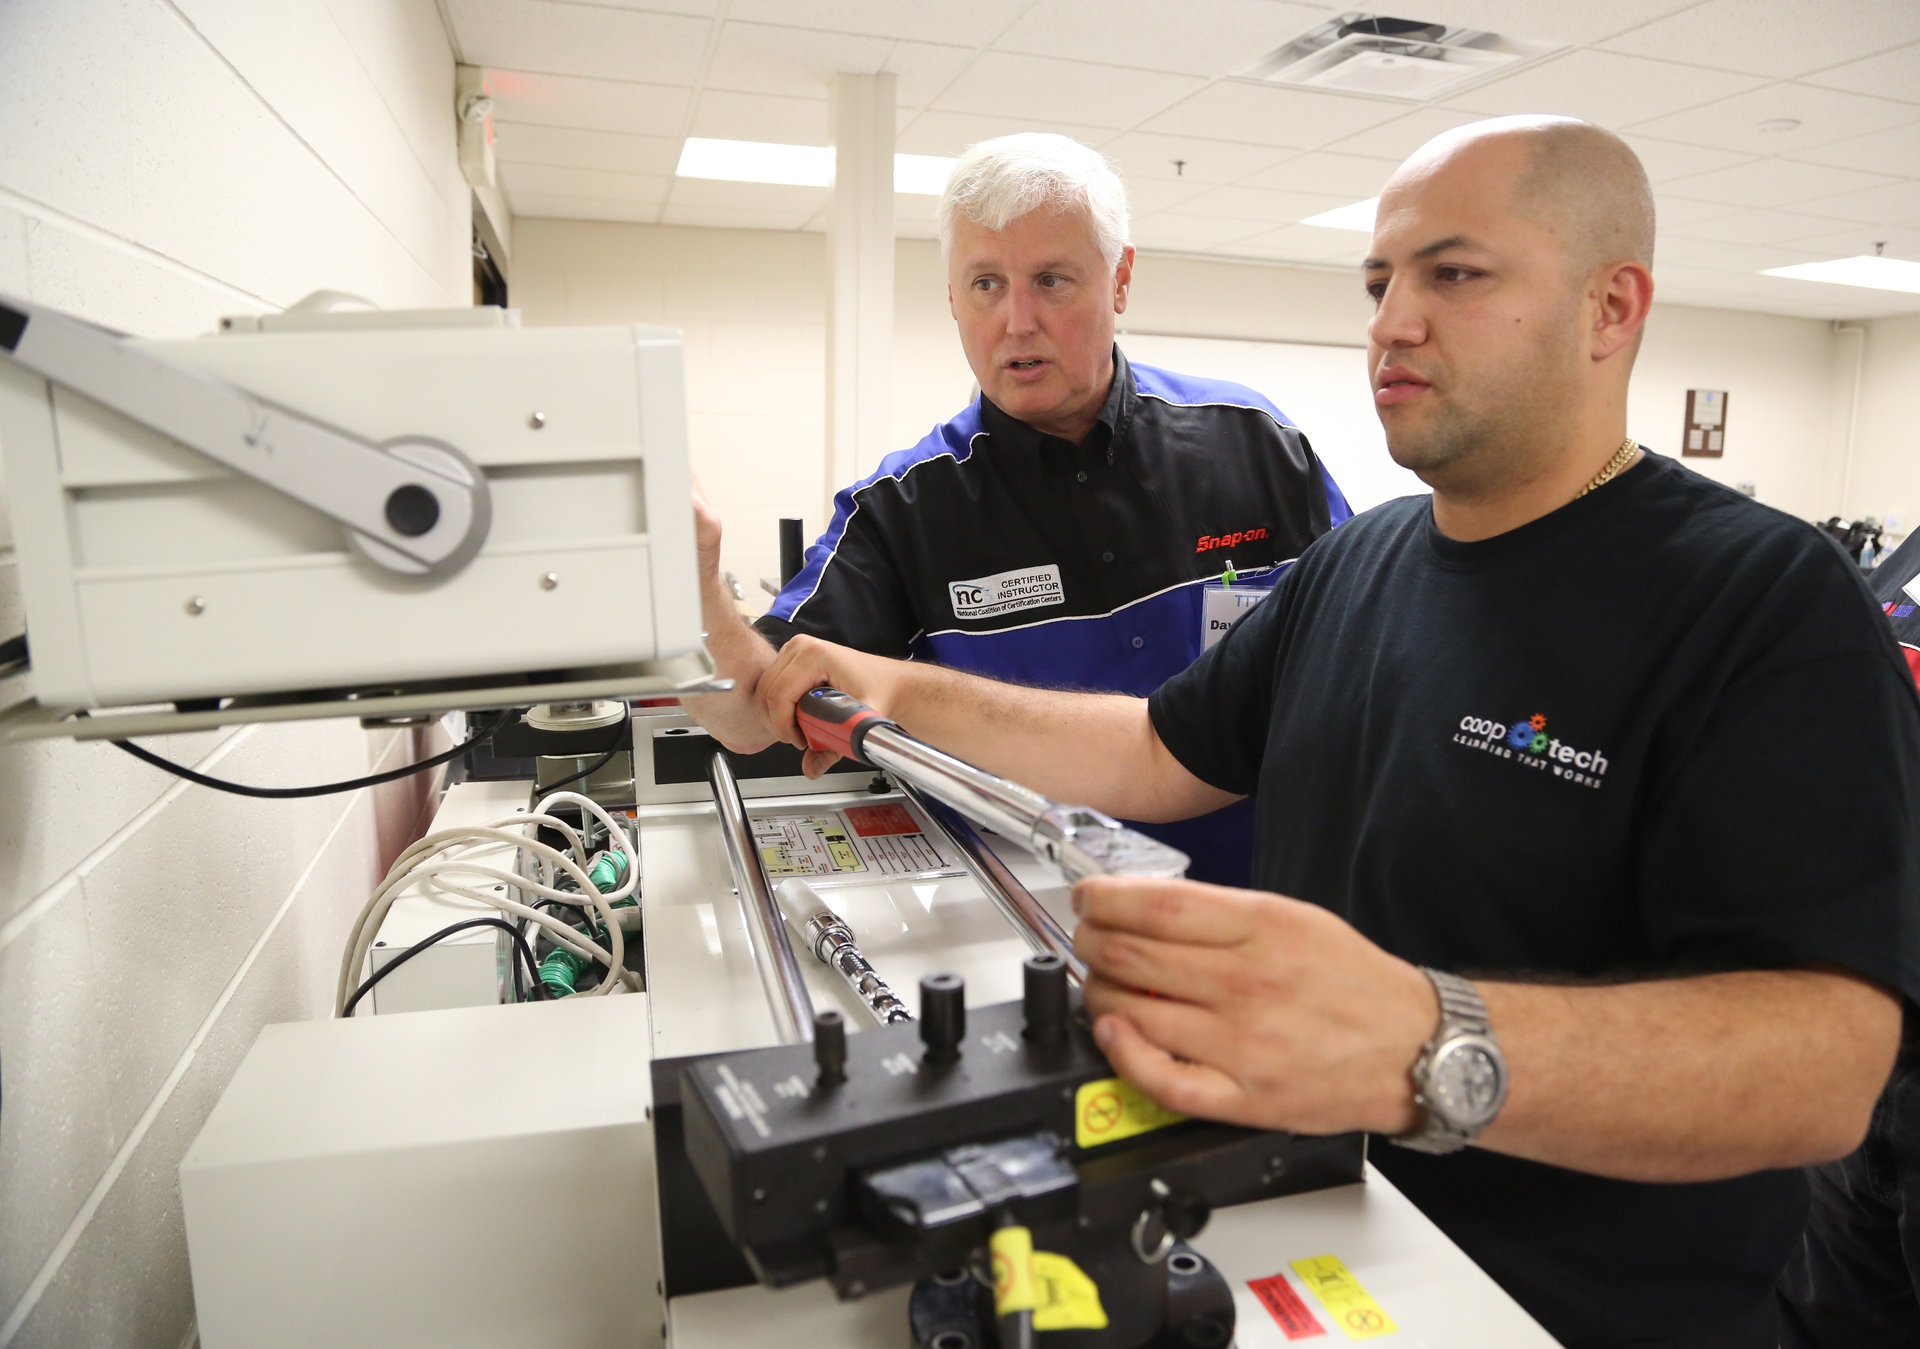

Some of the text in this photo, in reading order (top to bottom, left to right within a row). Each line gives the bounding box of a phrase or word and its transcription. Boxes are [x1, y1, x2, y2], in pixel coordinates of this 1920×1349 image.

[1195, 528, 1267, 553] Snap-on
[997, 582, 1060, 600] INSTRUCTOR
[1001, 573, 1052, 589] CERTIFIED
[956, 594, 1063, 617] National Coalition of Certification Centers
[1460, 715, 1609, 775] coop tech
[1453, 733, 1602, 789] LEARNING THAT WORKS
